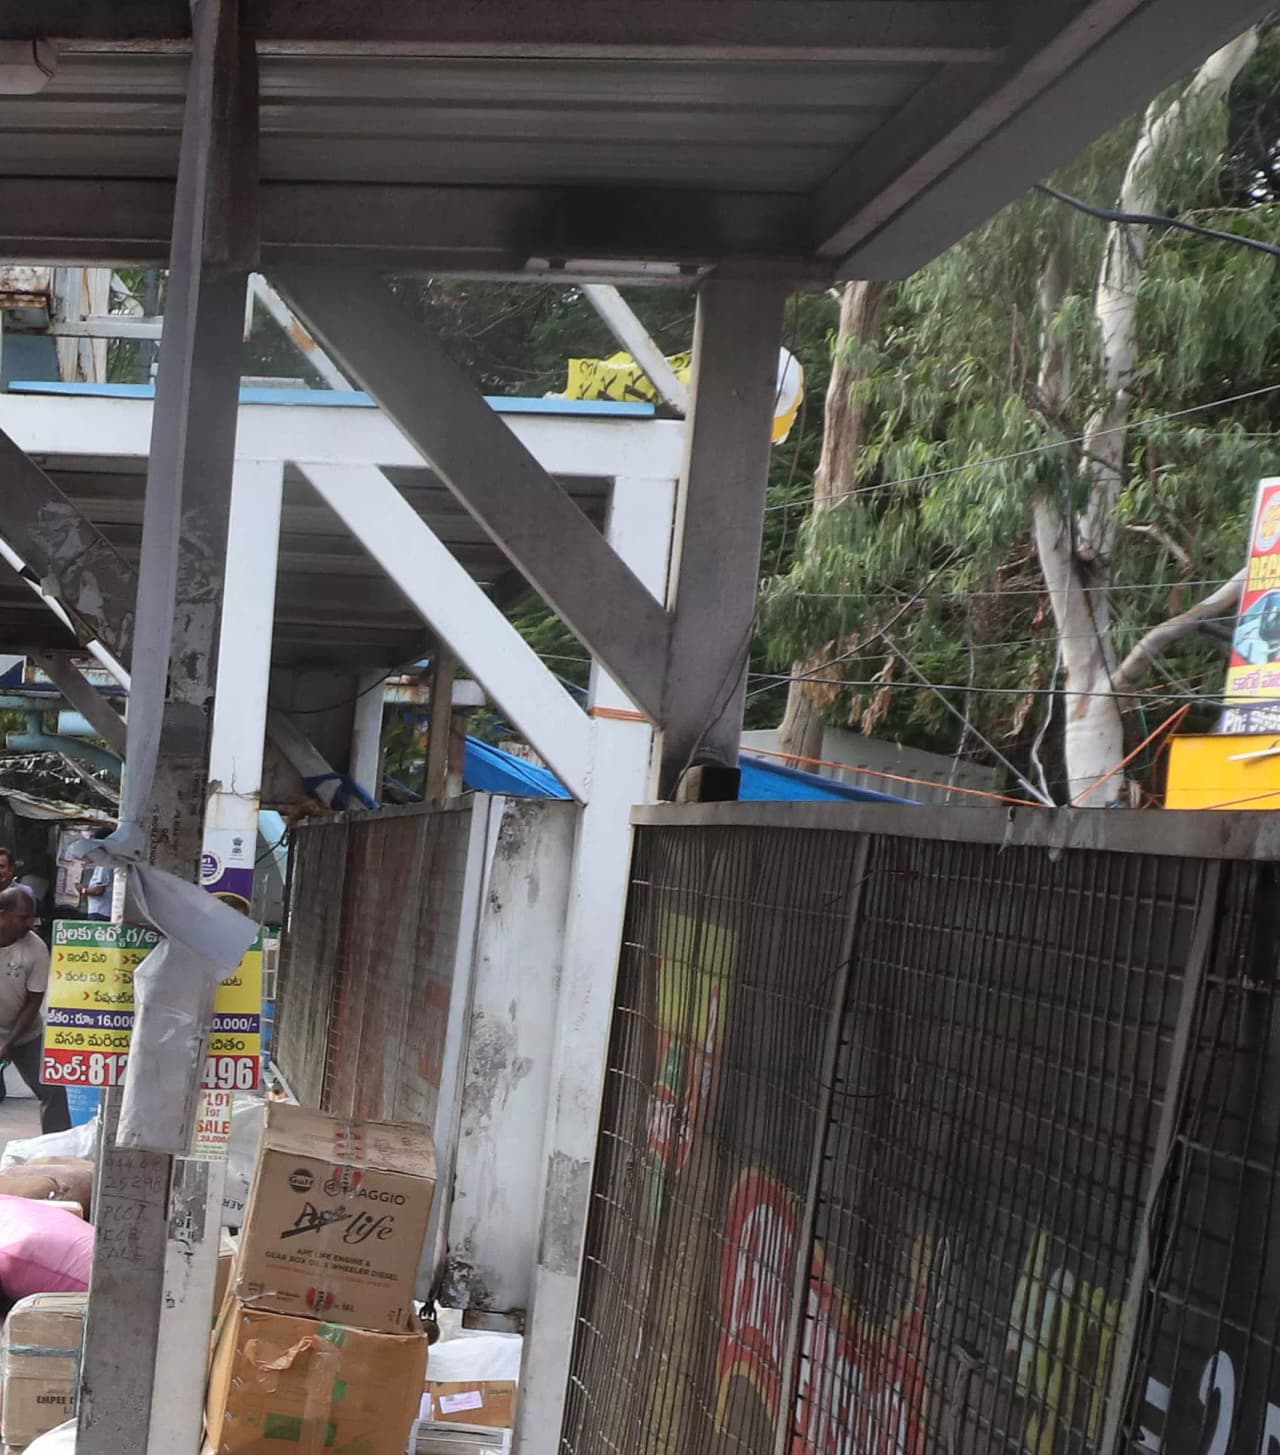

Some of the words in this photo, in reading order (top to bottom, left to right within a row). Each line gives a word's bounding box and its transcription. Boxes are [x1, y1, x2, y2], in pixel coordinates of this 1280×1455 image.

[197, 1121, 230, 1133] SALE
[265, 1252, 287, 1260] GEAR
[289, 1255, 305, 1264] BOX
[371, 1270, 398, 1281] DIESEL
